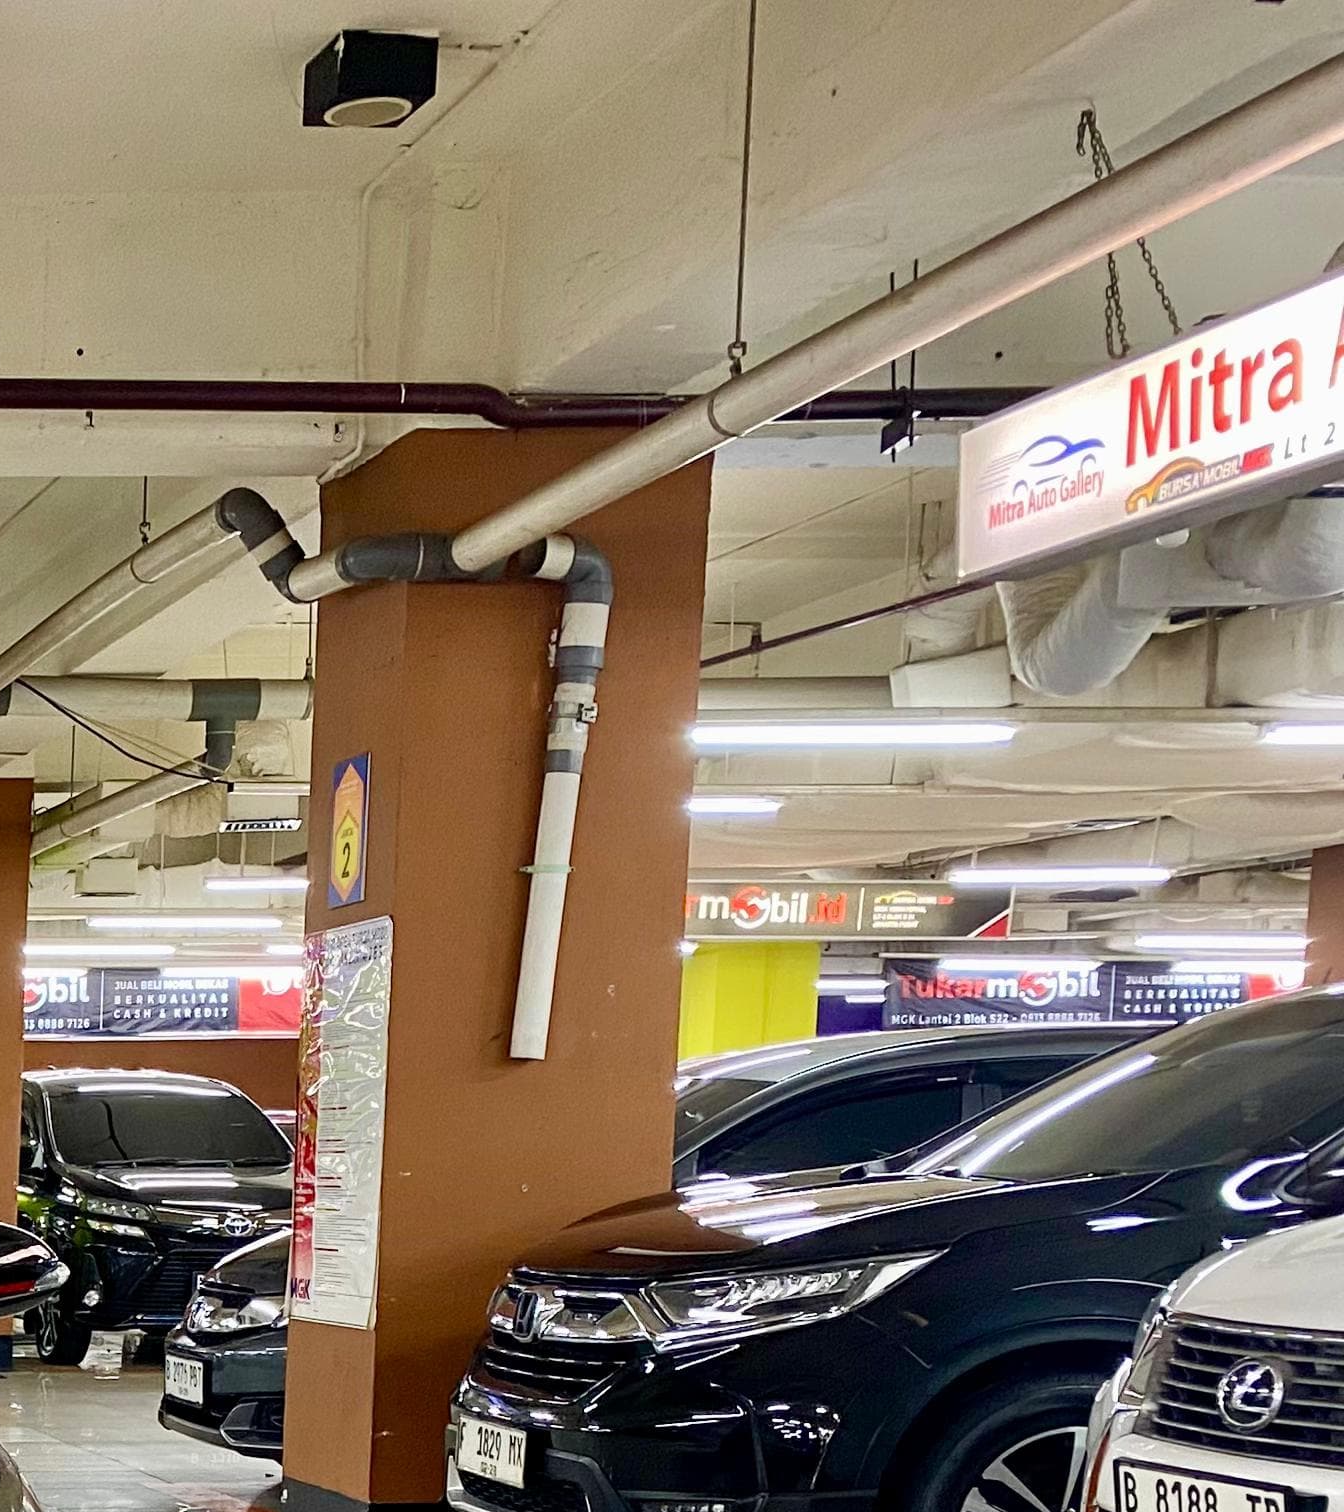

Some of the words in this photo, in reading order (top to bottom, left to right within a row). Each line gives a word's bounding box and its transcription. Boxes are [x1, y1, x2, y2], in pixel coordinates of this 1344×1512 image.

[1126, 338, 1303, 468] Mitra
[1323, 422, 1336, 446] 2
[988, 500, 1024, 529] Mitra
[1028, 487, 1057, 514] Auto
[1060, 469, 1104, 502] Gallery
[341, 841, 351, 879] 2
[114, 980, 139, 990] JUAL
[114, 993, 229, 1005] BERKUALITAS
[1123, 988, 1241, 1000] BERKUALITAS
[113, 1007, 152, 1019] CASH
[174, 1006, 229, 1019] KREDIT
[1123, 1003, 1162, 1014] CASH
[66, 1017, 90, 1028] 7126
[953, 1013, 961, 1024] 2
[964, 1012, 987, 1024] Blok
[476, 1426, 502, 1461] 1829
